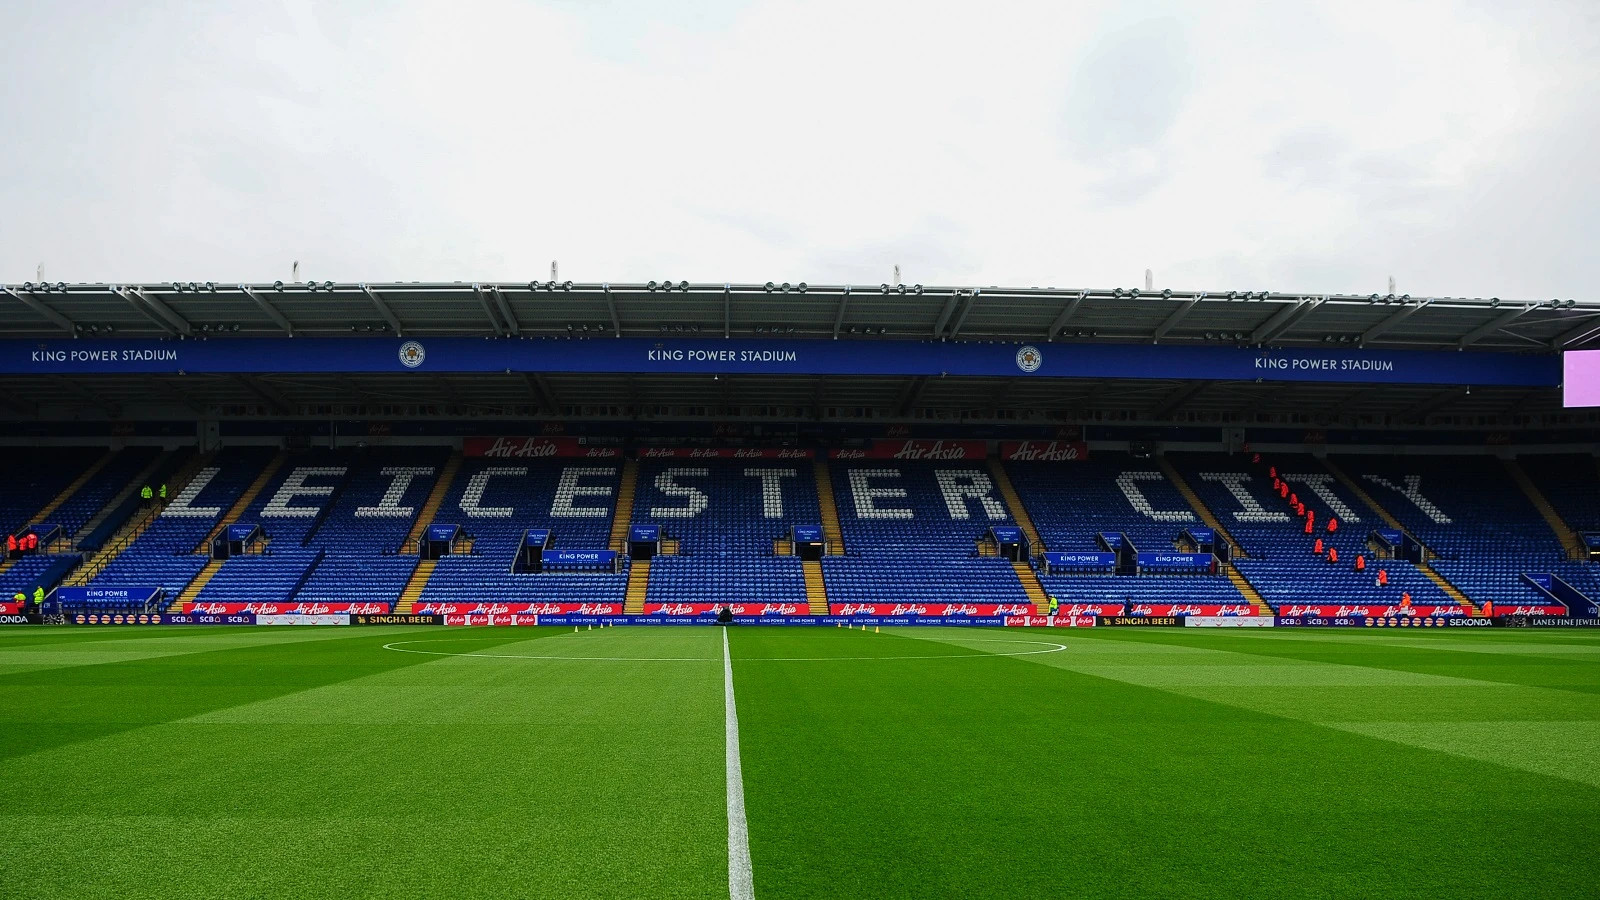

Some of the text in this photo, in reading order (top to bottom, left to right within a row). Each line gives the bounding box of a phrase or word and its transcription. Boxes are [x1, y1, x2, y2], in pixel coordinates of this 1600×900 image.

[32, 350, 177, 362] KING POWER STADIUM
[648, 350, 797, 362] KING POWER STADIUM
[1255, 358, 1393, 371] KING POWER STADIUM
[710, 604, 745, 614] Aisia
[1117, 605, 1152, 616] AAsia
[1383, 606, 1416, 616] Airia
[0, 616, 28, 624] ONDA
